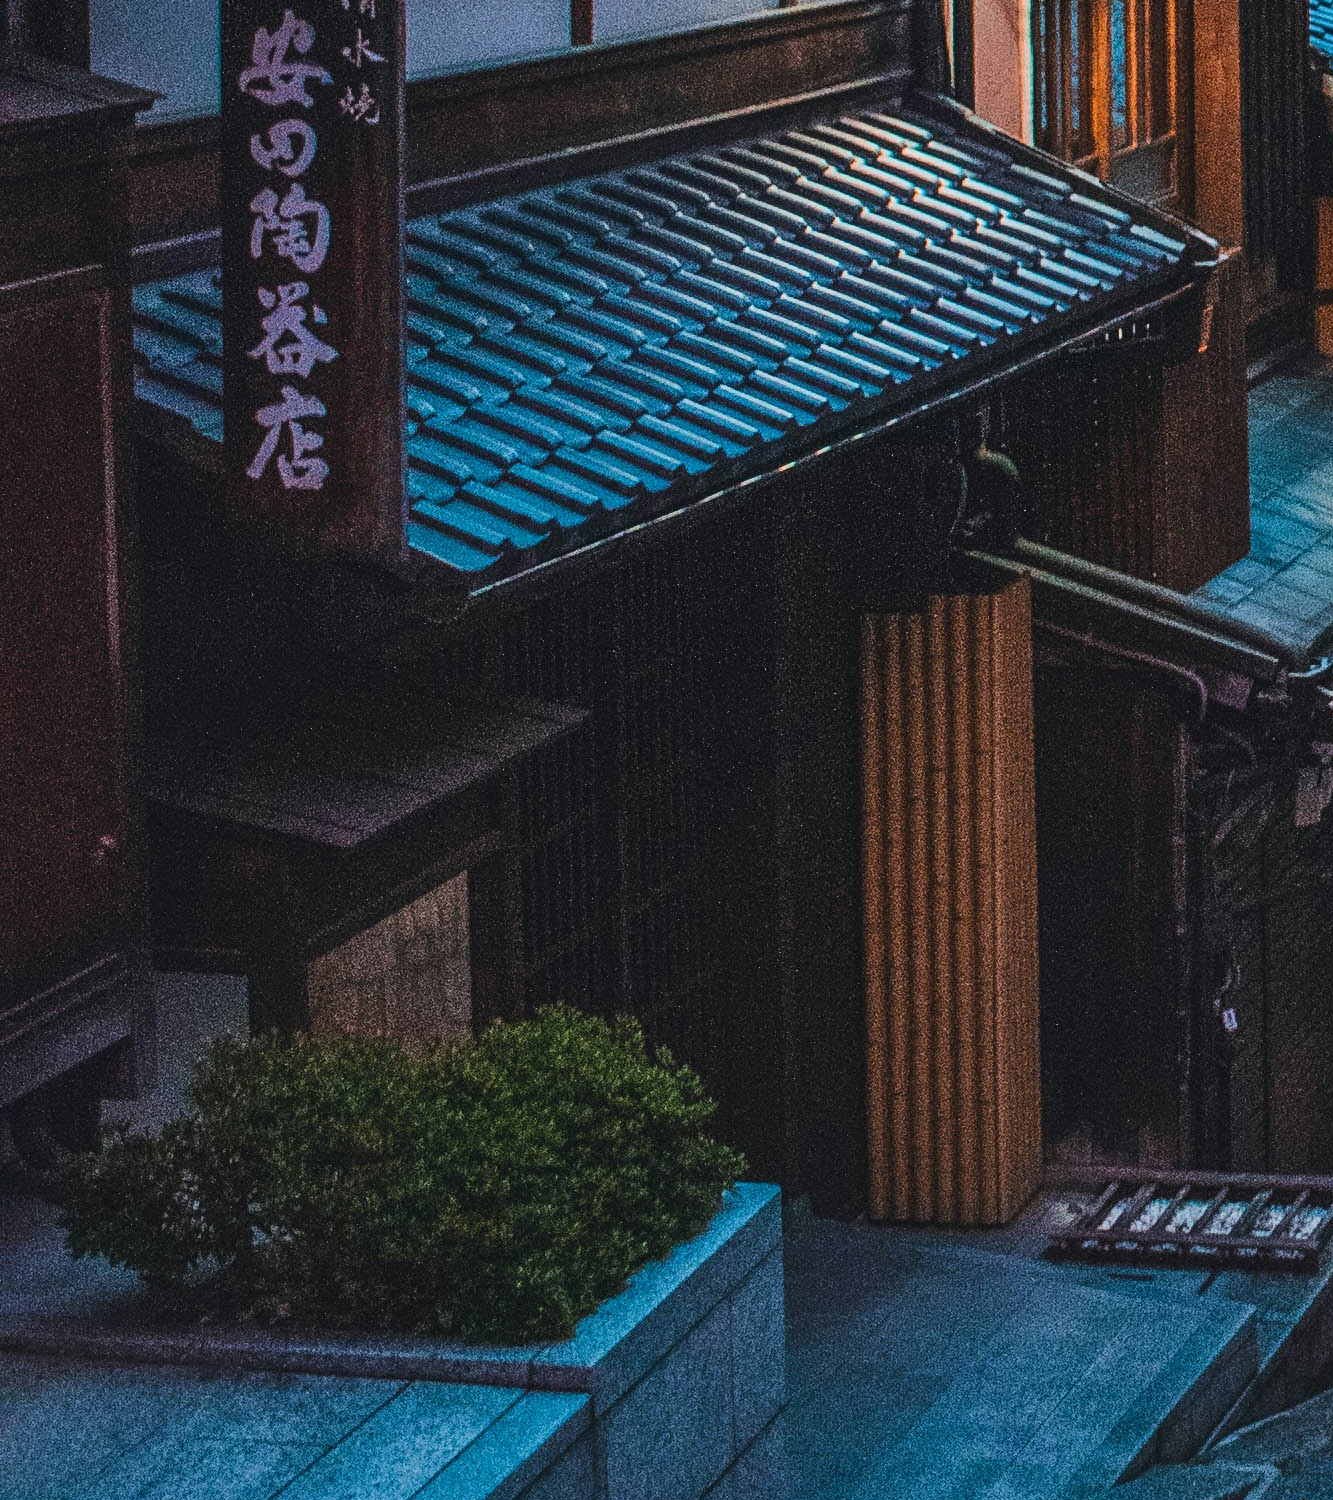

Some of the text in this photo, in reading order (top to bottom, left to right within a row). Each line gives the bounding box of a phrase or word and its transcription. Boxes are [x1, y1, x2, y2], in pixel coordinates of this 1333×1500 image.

[240, 9, 340, 491] 安田陶器店
